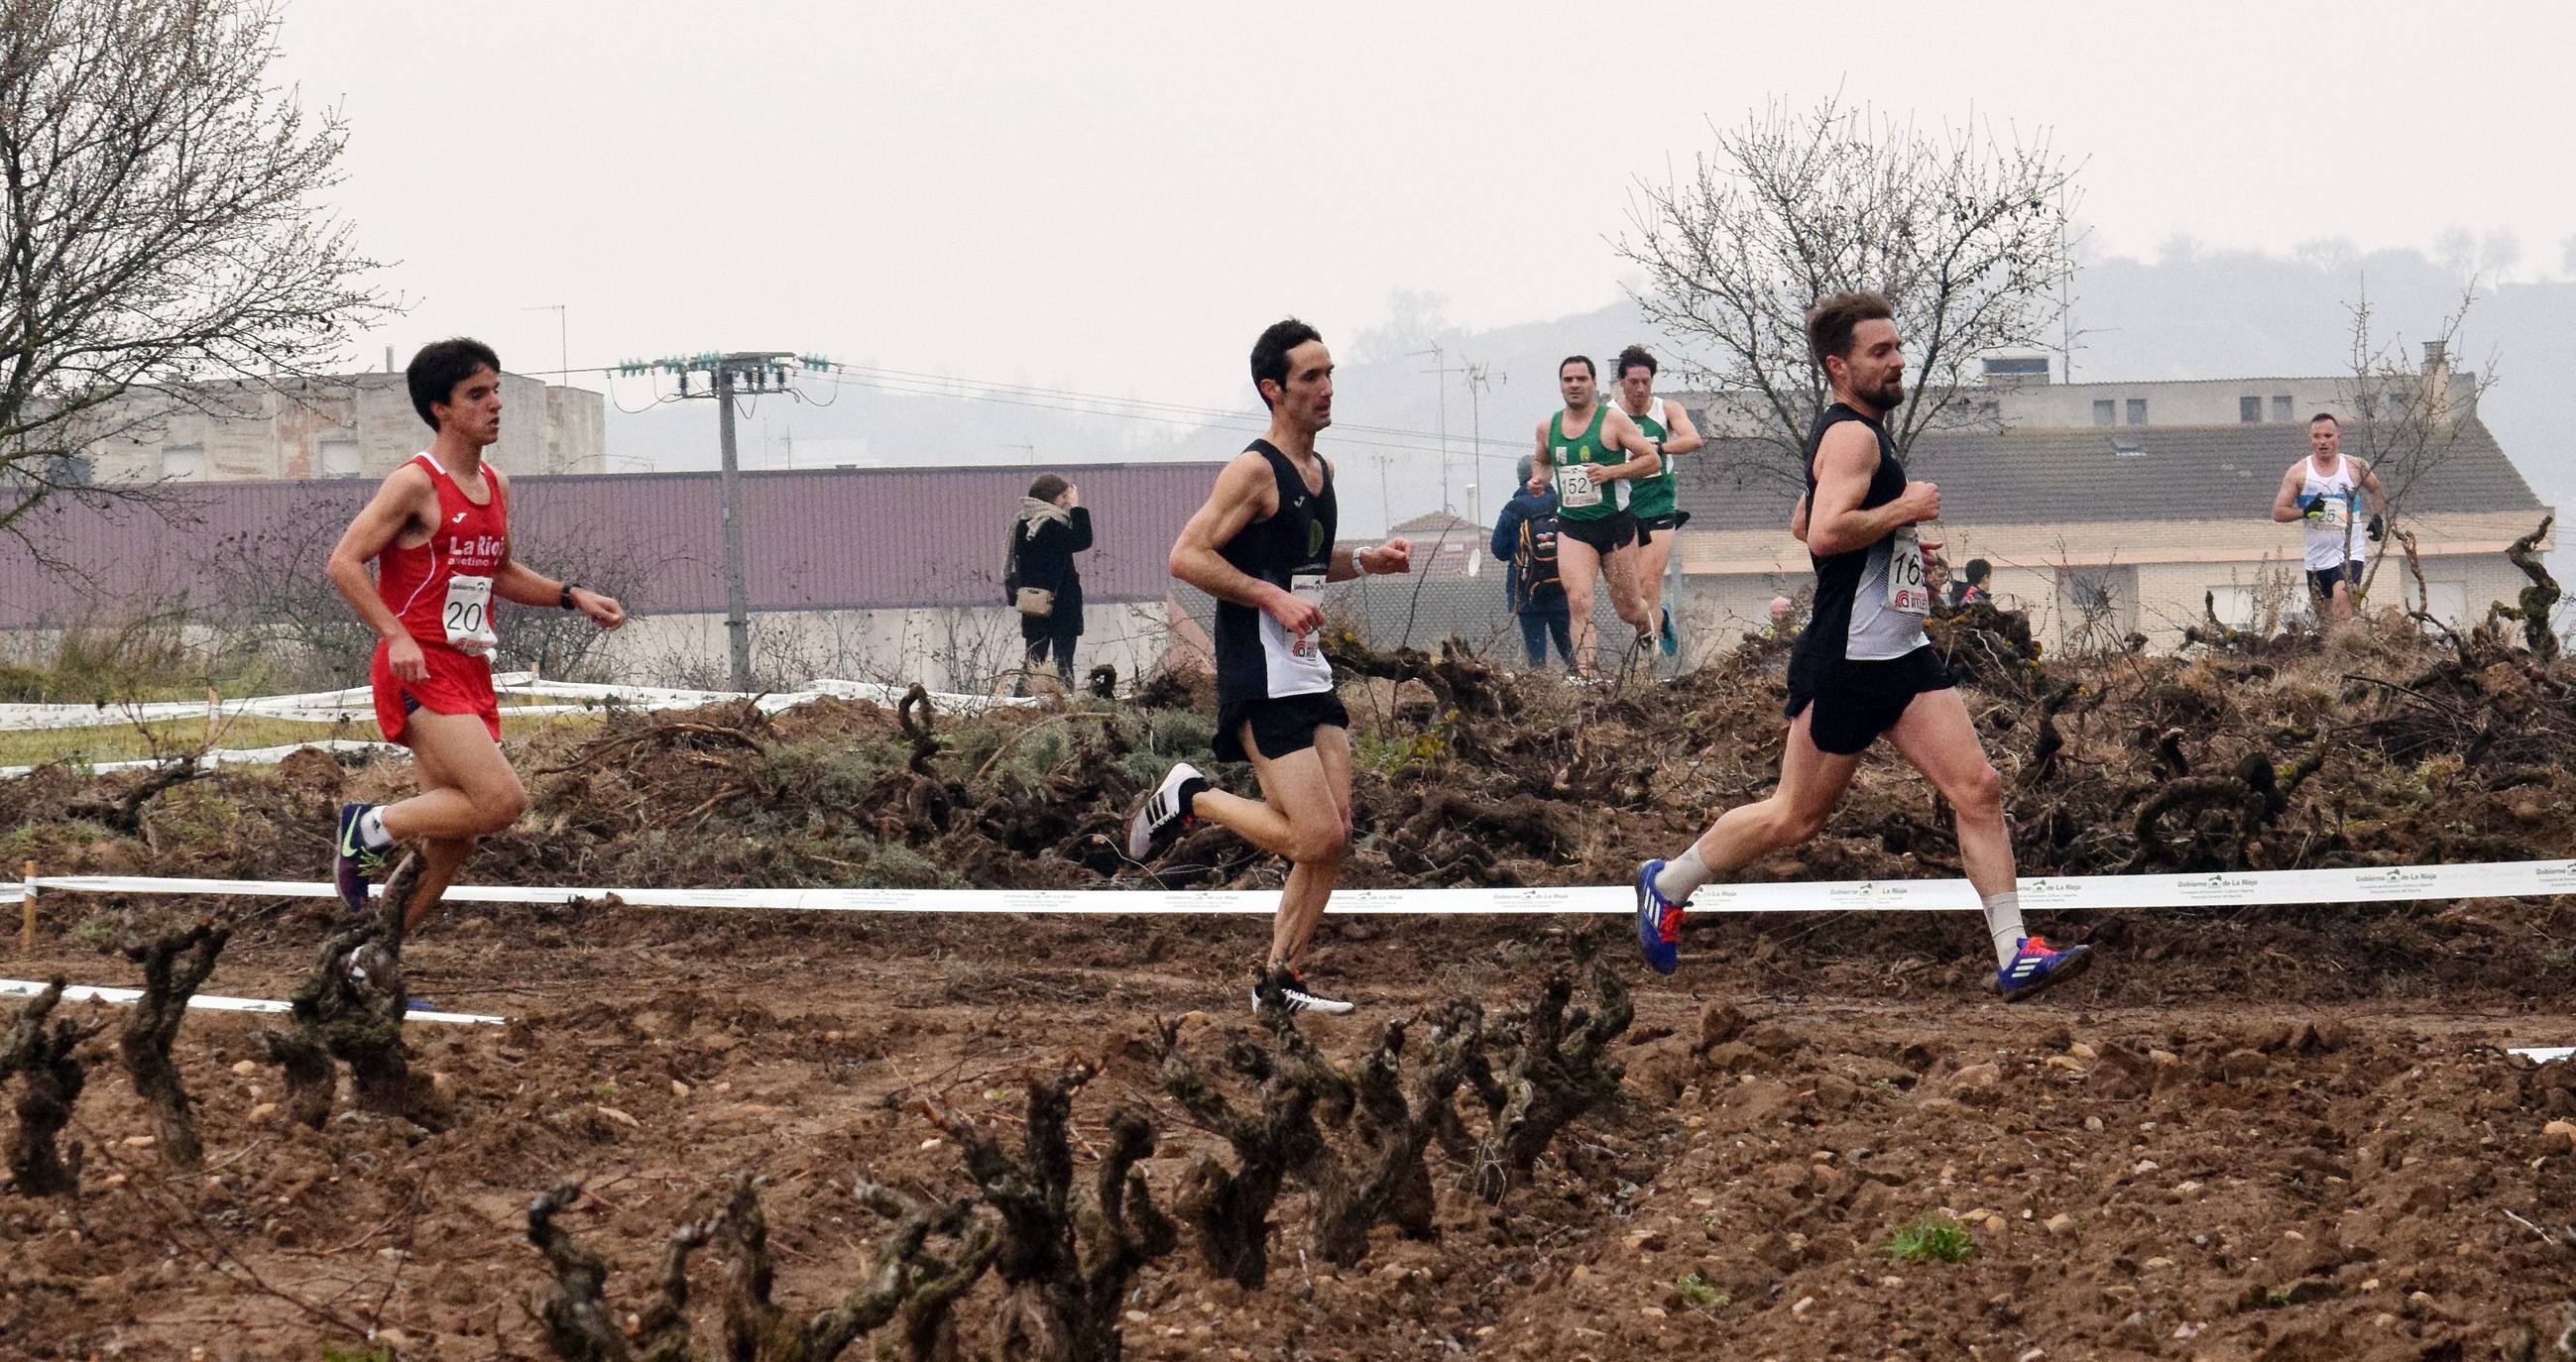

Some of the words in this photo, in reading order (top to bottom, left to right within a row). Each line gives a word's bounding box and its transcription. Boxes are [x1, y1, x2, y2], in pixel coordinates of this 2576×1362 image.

[449, 536, 474, 555] La
[478, 536, 505, 559] Rioj
[1895, 552, 1927, 587] 16
[446, 602, 489, 633] 20
